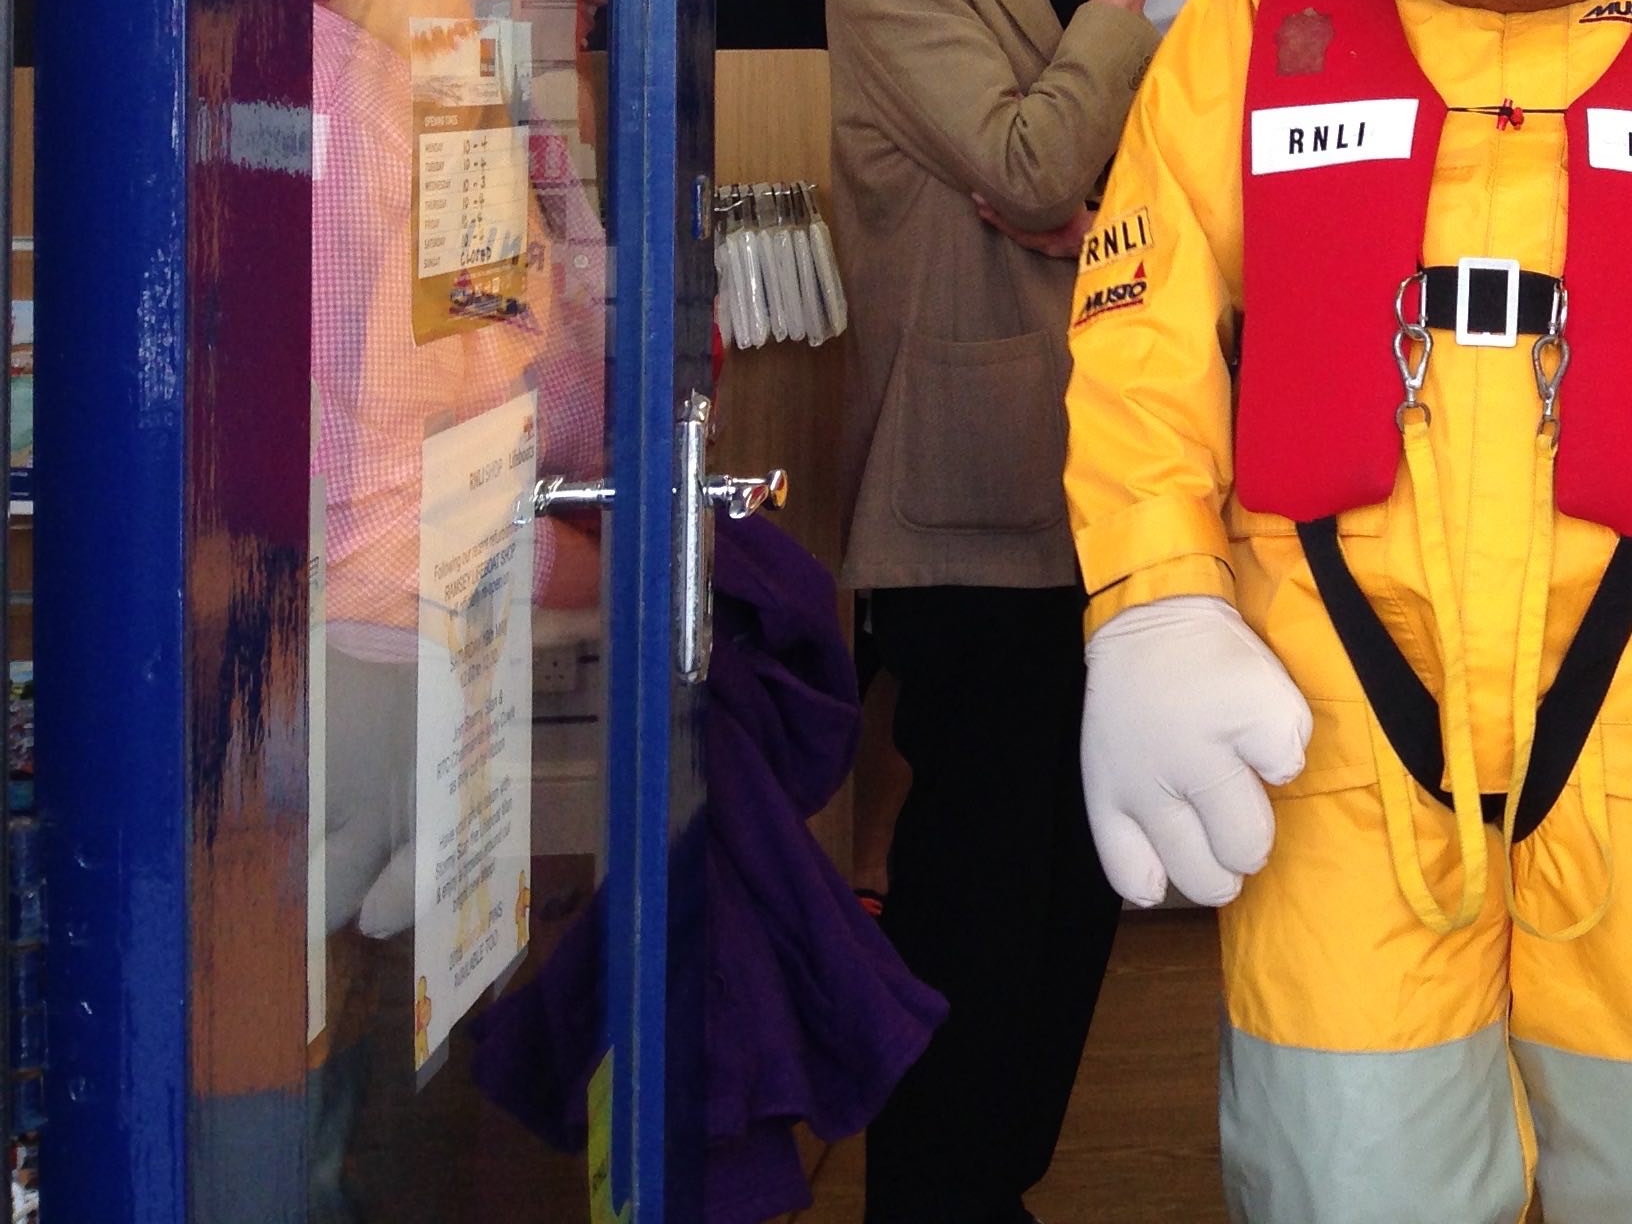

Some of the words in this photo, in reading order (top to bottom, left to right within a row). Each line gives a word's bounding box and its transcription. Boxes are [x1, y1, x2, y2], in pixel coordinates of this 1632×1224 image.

[1289, 122, 1366, 155] RNLI
[1086, 213, 1147, 266] RNLI
[1080, 280, 1147, 315] MUSTO
